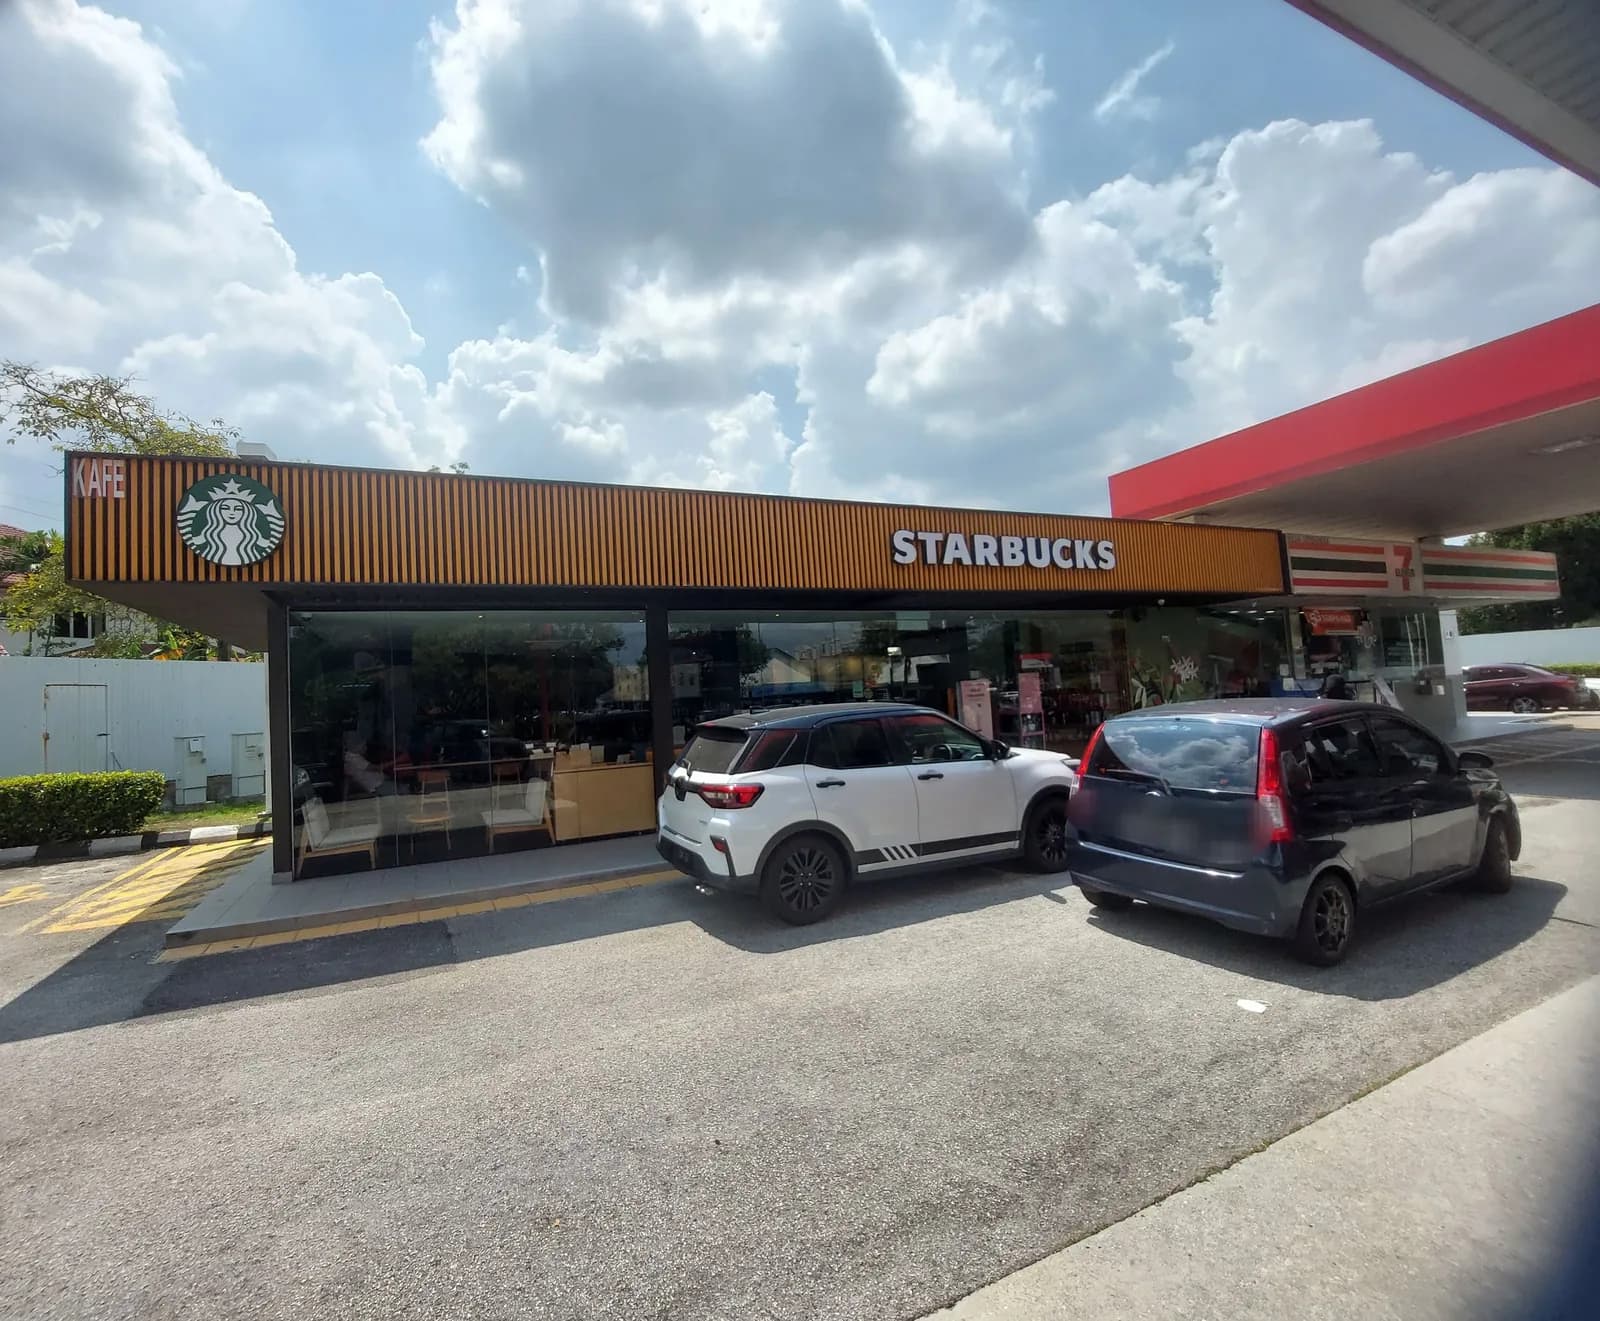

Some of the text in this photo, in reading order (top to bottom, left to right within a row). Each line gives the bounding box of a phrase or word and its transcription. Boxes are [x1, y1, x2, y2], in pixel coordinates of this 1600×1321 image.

[72, 458, 125, 498] KAFE
[892, 529, 1116, 571] STARBUCKS
[1393, 545, 1412, 592] 7
